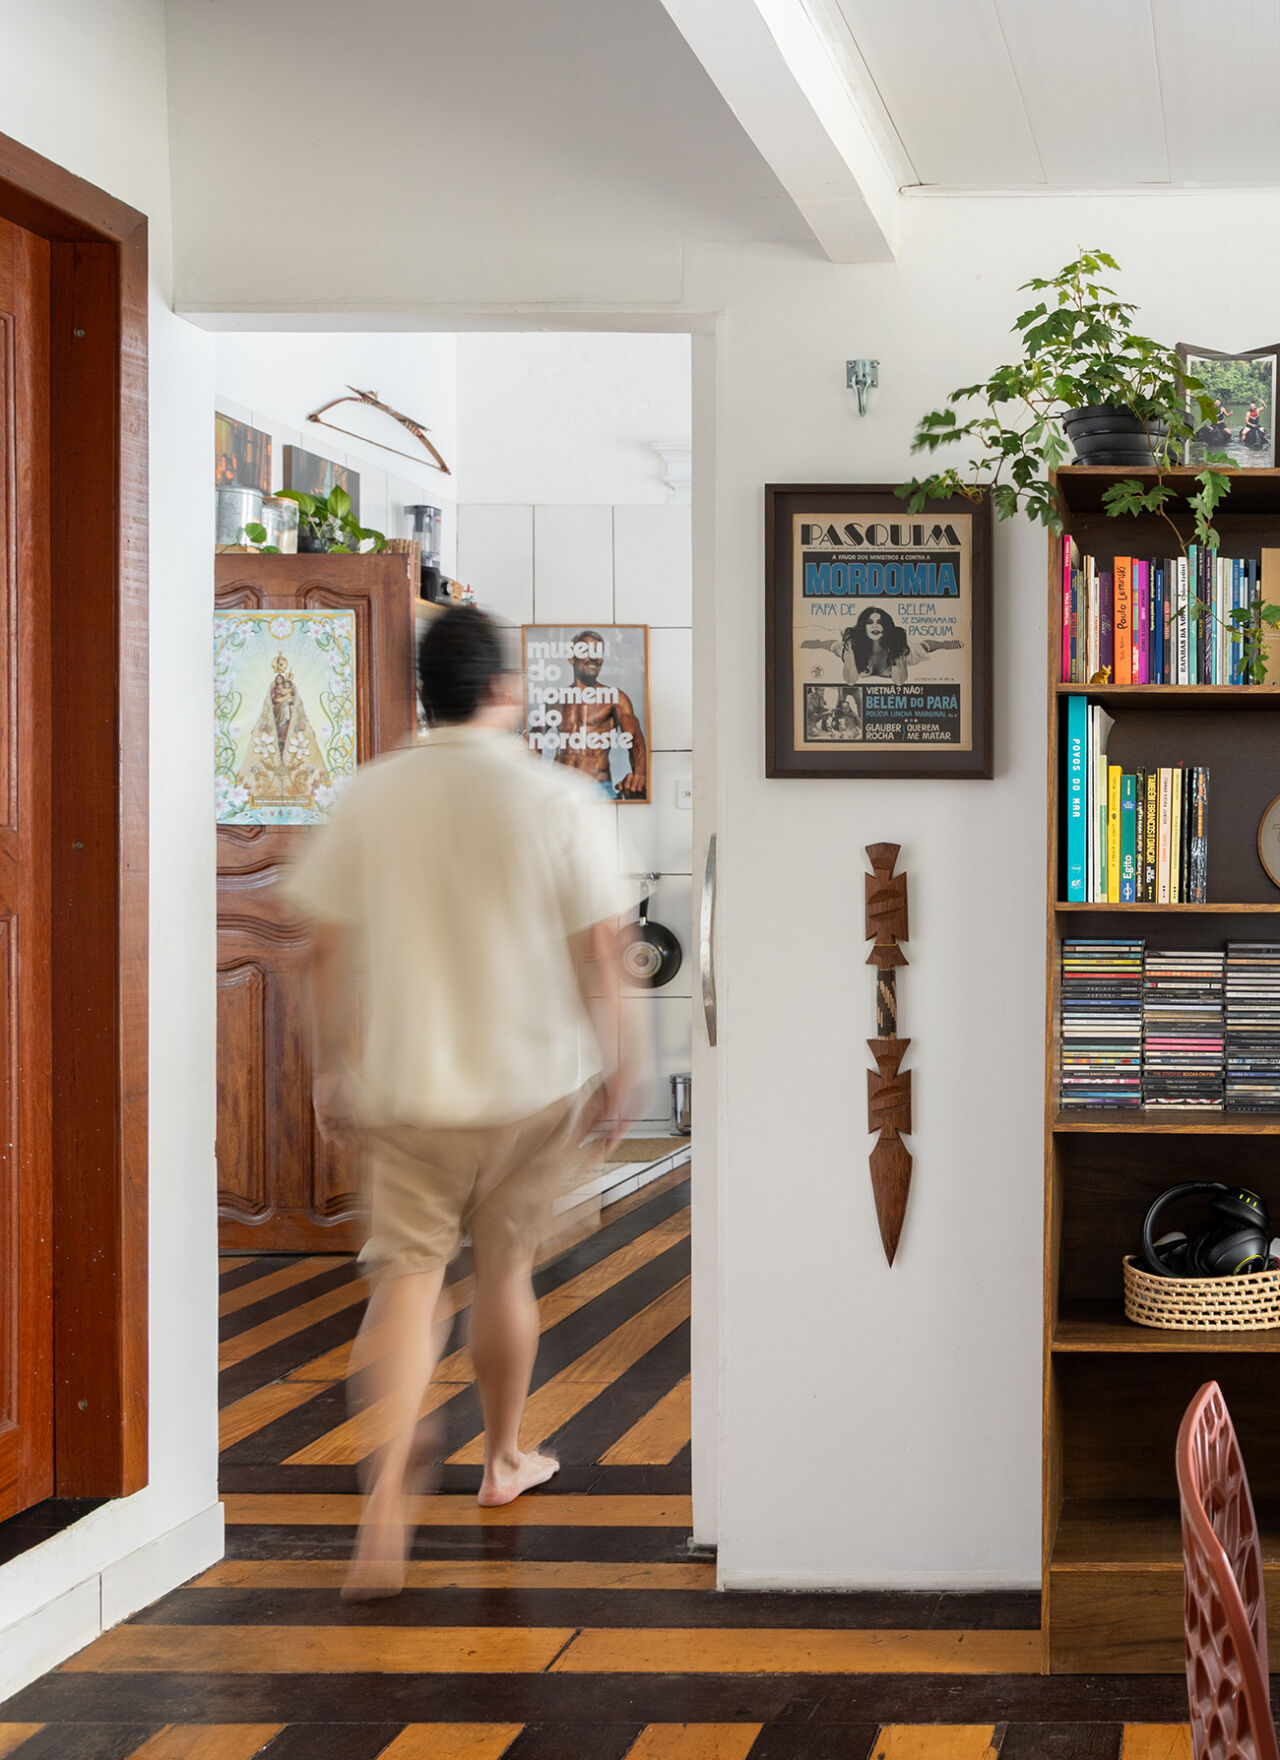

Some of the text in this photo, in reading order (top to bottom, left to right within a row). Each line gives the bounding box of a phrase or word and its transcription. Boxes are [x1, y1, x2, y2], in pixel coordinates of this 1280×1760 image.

[801, 522, 961, 546] PASQUIM
[806, 562, 958, 596] MORDOMIA
[1117, 566, 1128, 630] Paulo Leminski
[840, 602, 856, 616] DE
[909, 626, 954, 637] PASQUIM
[1179, 630, 1186, 638] DA
[528, 640, 604, 660] museu
[528, 658, 562, 682] do
[528, 682, 620, 705] homem
[866, 692, 958, 710] BELÉM DO PARÁ
[528, 704, 562, 727] do
[866, 723, 902, 733] GLAUBER
[866, 732, 894, 741] ROCHA
[907, 723, 940, 732] QUEREM
[907, 732, 951, 741] ME MATAR
[528, 727, 634, 750] nordeste
[1072, 738, 1080, 771] POVOS
[1072, 778, 1080, 791] DO
[1147, 804, 1156, 834] BRANCOS
[1123, 854, 1135, 879] Egito
